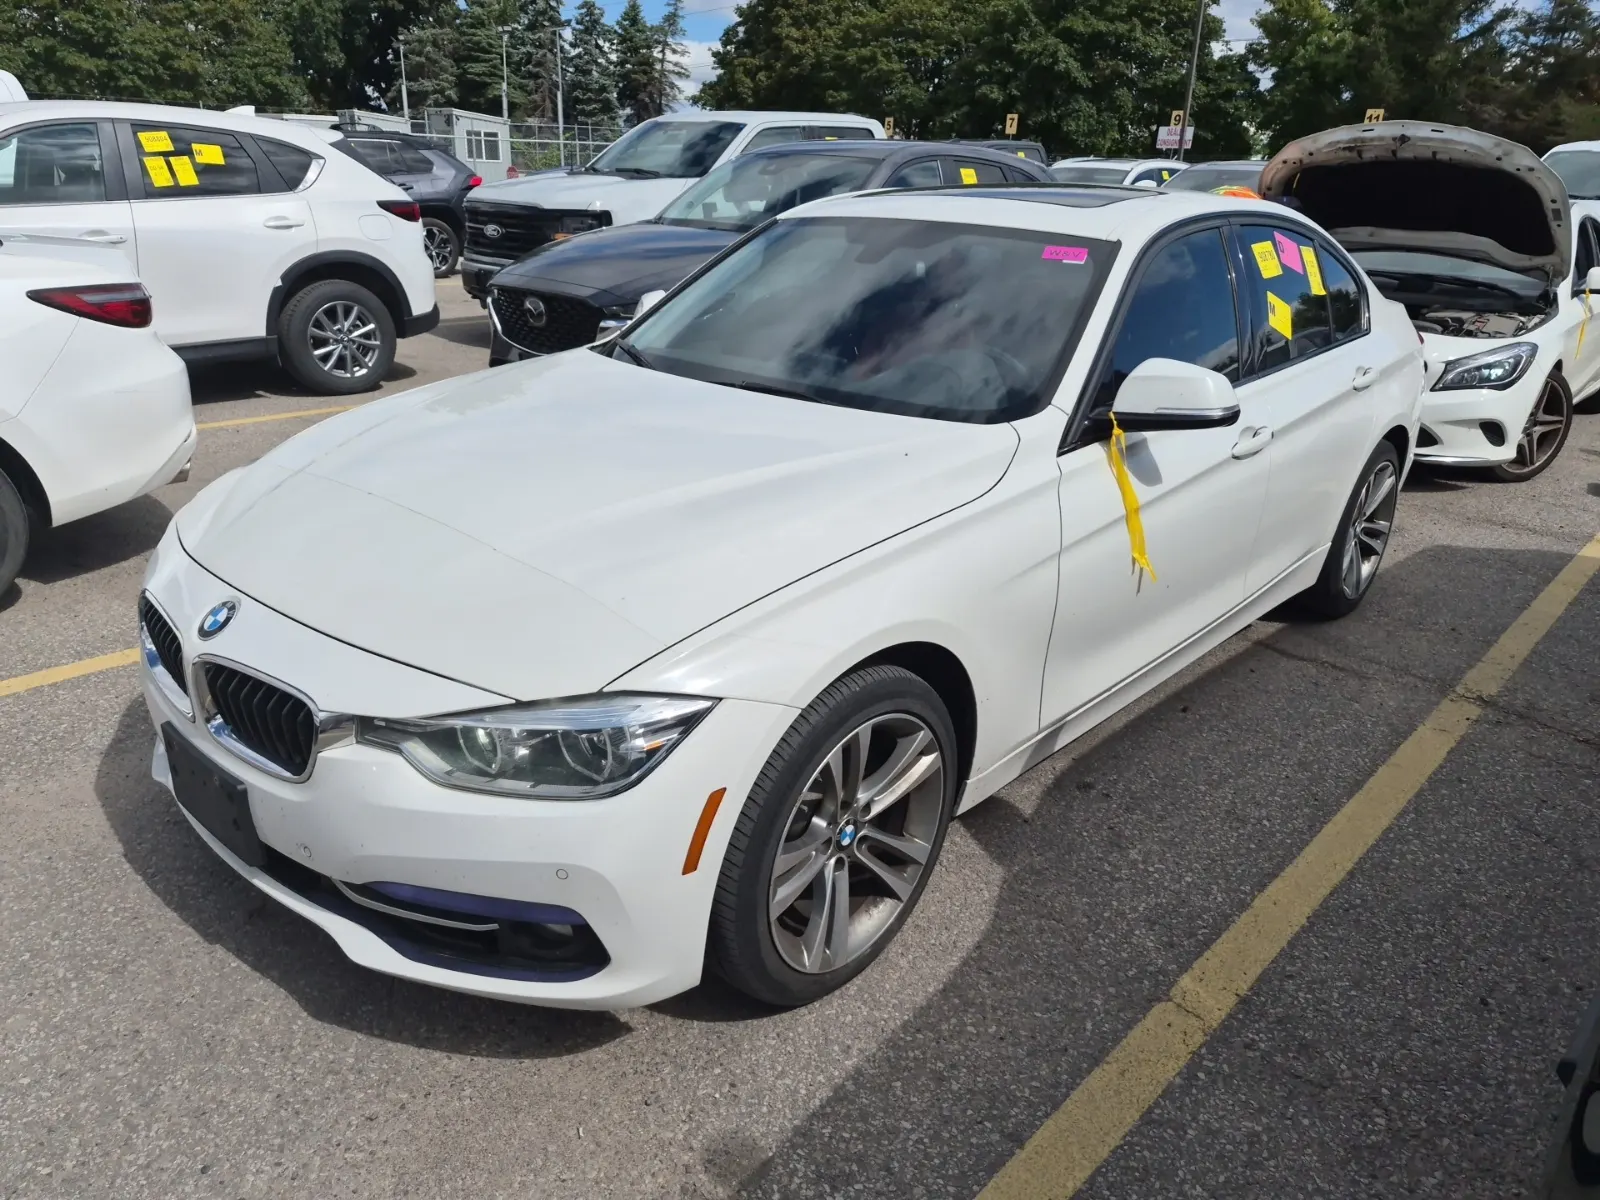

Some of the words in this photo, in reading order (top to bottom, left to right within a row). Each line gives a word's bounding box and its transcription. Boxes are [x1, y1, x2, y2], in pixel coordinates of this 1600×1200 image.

[1009, 118, 1015, 128] 7
[1174, 114, 1181, 126] 9
[1367, 113, 1380, 123] 11
[886, 121, 892, 130] 5
[196, 148, 203, 157] M
[1277, 241, 1285, 254] D
[1269, 301, 1276, 317] M
